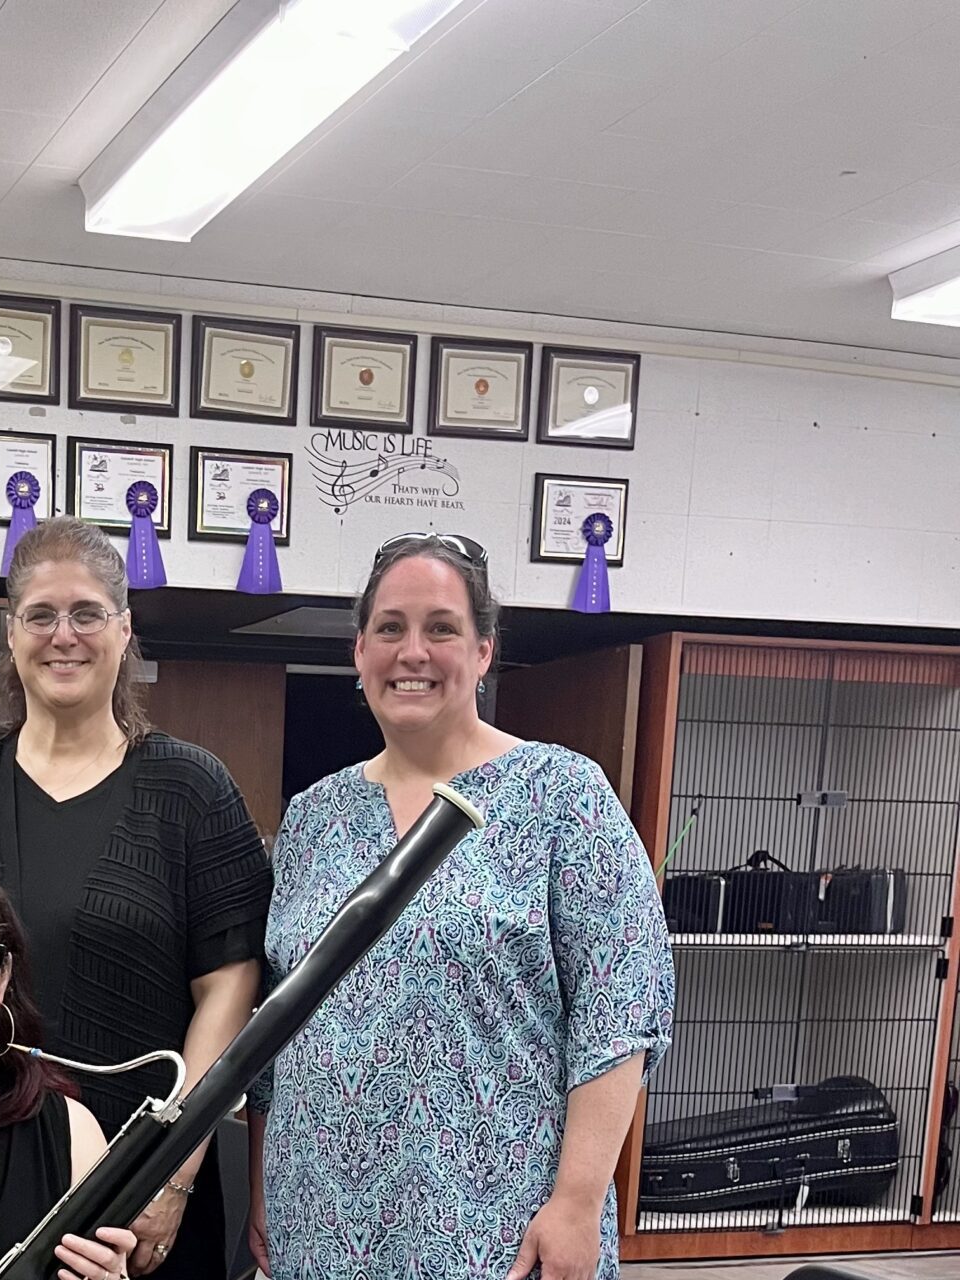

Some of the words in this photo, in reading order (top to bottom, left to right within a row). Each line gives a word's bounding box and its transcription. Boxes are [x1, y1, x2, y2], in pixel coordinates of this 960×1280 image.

[325, 428, 378, 452] MUSIC
[383, 434, 396, 453] IS
[401, 434, 433, 457] LIFE
[421, 487, 440, 496] WHY
[364, 495, 381, 504] OUR
[384, 496, 414, 506] HEARTS
[417, 498, 438, 508] HAVE
[553, 516, 572, 526] 2024
